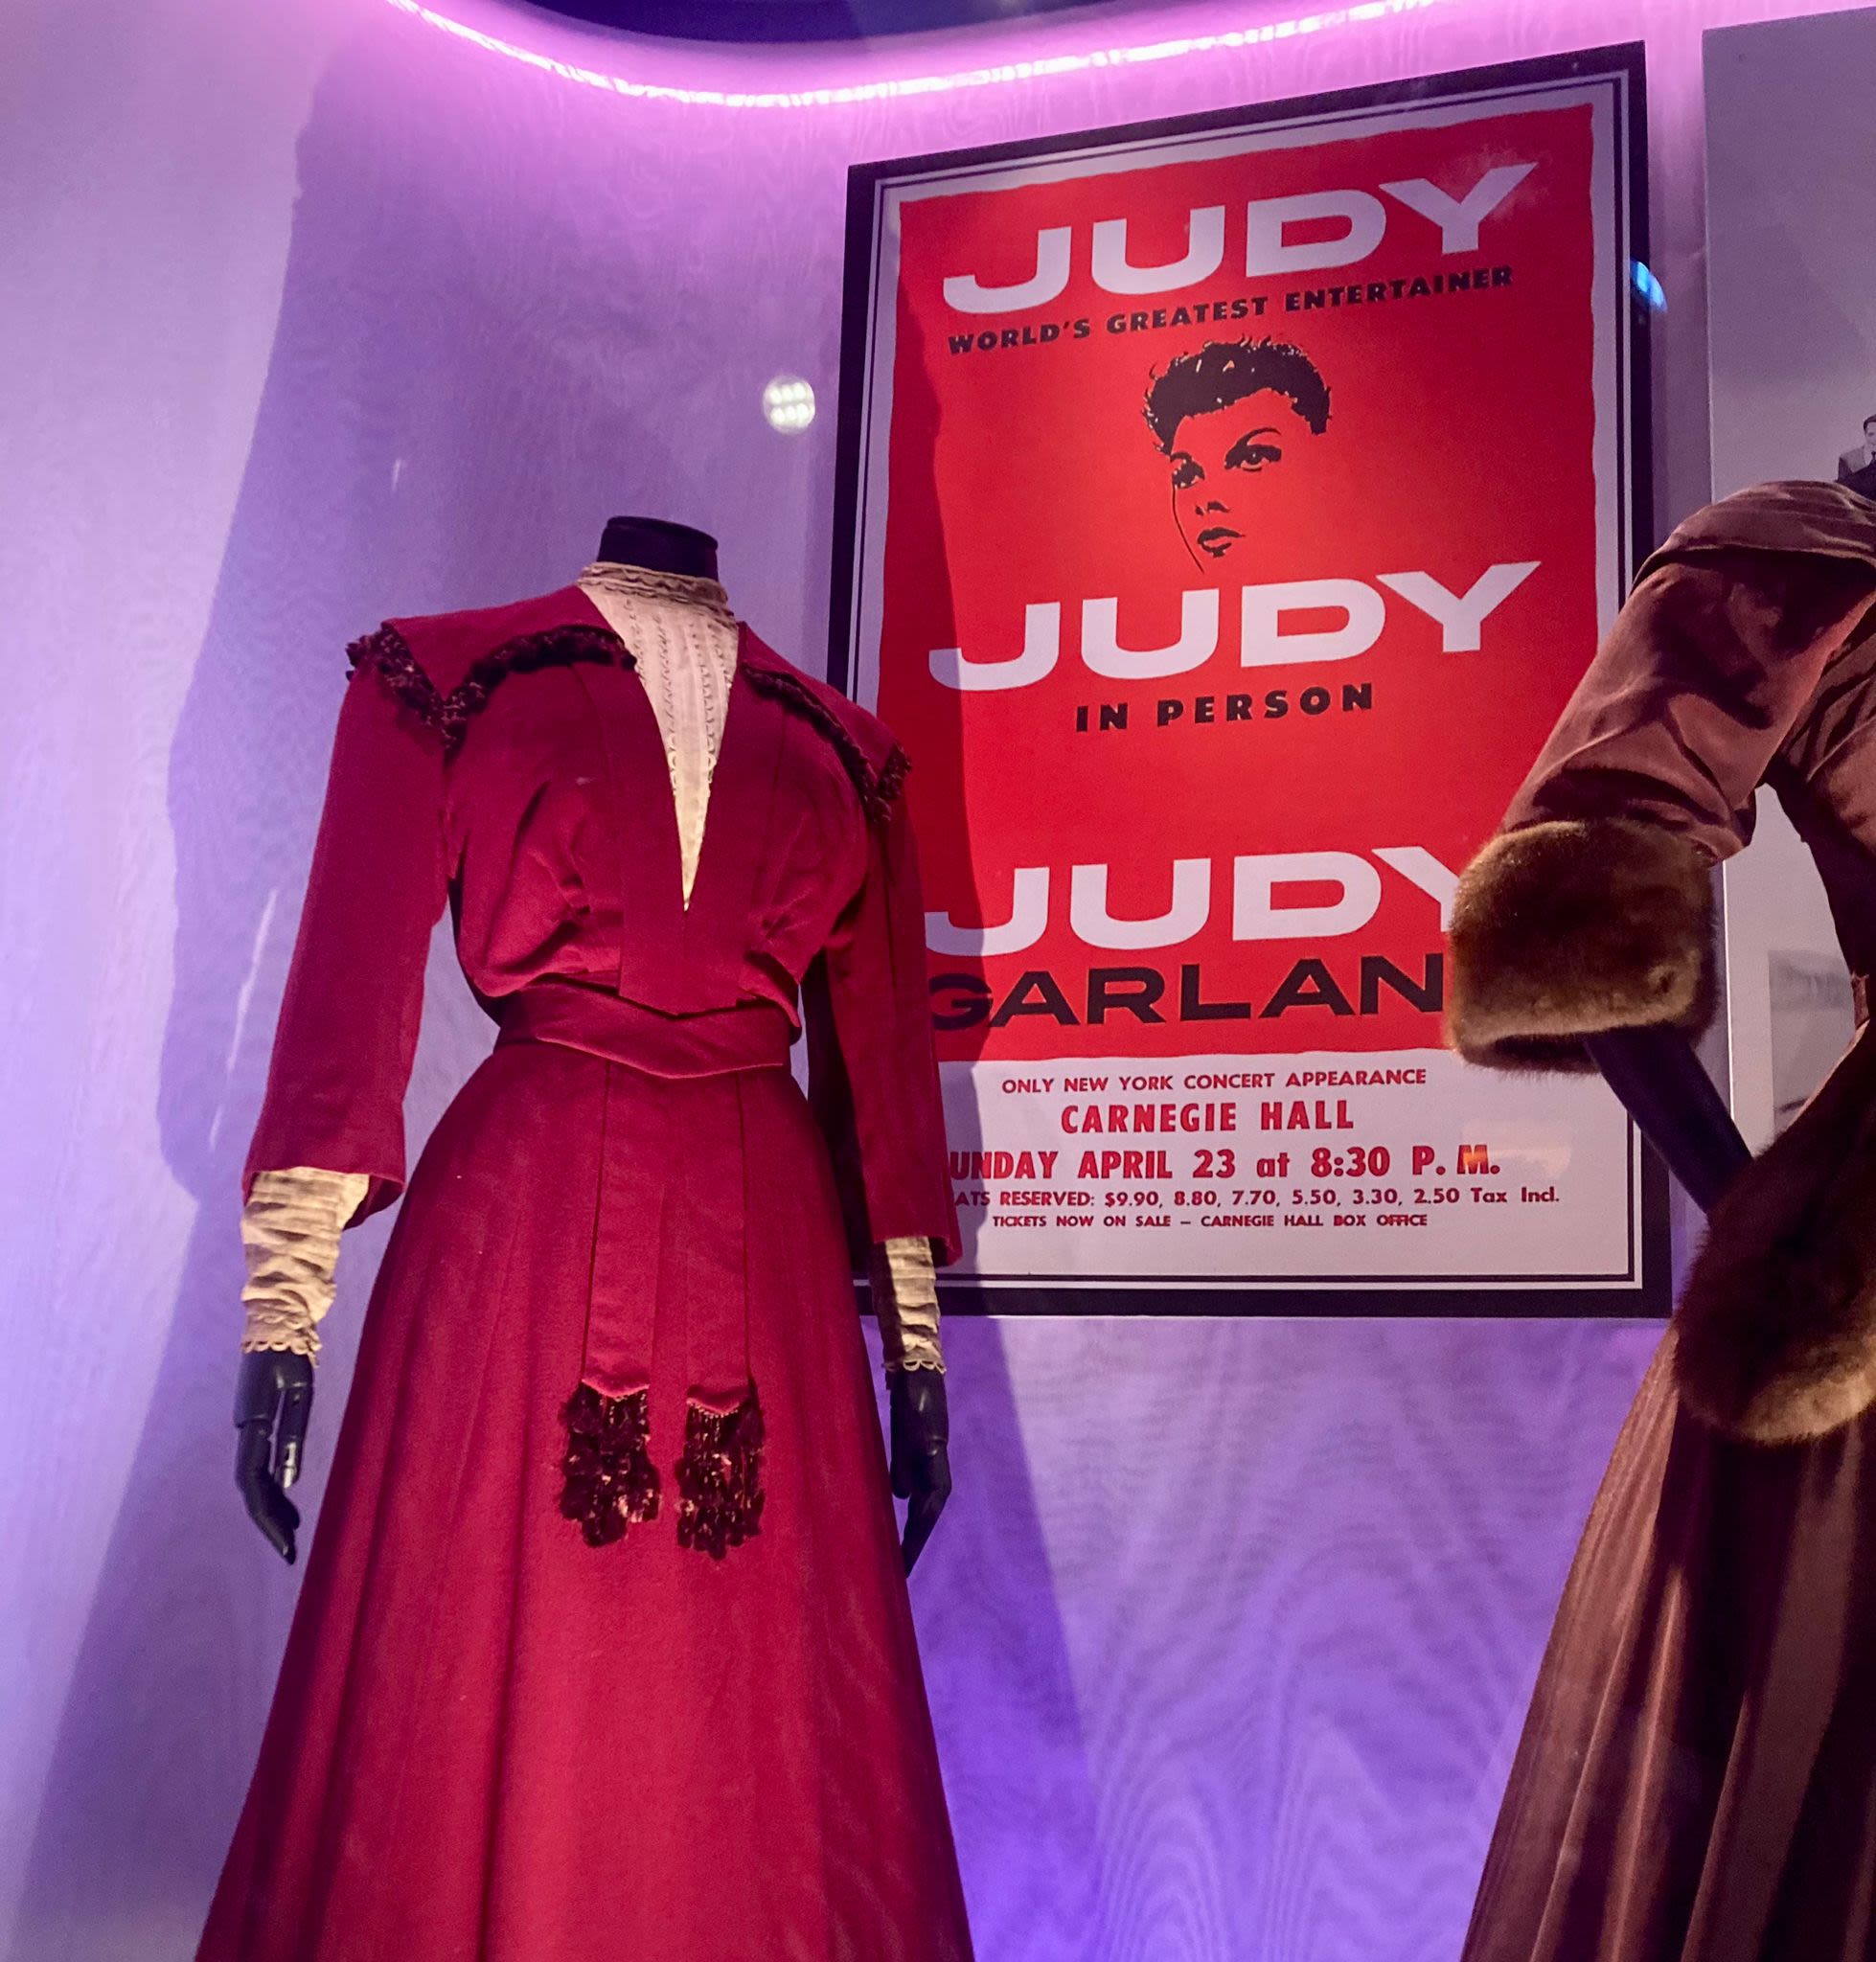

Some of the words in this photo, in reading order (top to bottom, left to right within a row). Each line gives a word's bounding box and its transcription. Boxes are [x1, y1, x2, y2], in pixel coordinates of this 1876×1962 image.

[943, 163, 1539, 313] JUDY
[948, 318, 1090, 354] WORLD'S
[1107, 296, 1269, 333] GREATEST
[1285, 265, 1513, 312] ENTERTAINER
[928, 561, 1541, 691] JUDY
[1076, 702, 1129, 732] IN
[1157, 682, 1372, 727] PERSON
[929, 953, 1444, 1031] GARLAN
[1001, 1078, 1055, 1093] ONLY
[1064, 1077, 1110, 1092] NEW
[1118, 1075, 1174, 1091] YORK
[1183, 1072, 1275, 1089] CONCERT
[1285, 1068, 1427, 1087] APPEARANCE
[1061, 1102, 1237, 1134] CARNEGIE
[1260, 1099, 1354, 1131] HALL
[949, 1151, 1059, 1180] UNDAY
[1077, 1150, 1173, 1179] APRIL
[1192, 1149, 1236, 1179] 23
[1256, 1152, 1291, 1178] at
[1311, 1146, 1391, 1178] 8:30
[954, 1191, 991, 1207] ATS
[999, 1191, 1095, 1207] RESERVED:
[1104, 1190, 1163, 1209] $9.90,
[1174, 1190, 1222, 1208] 8.80,
[1232, 1189, 1280, 1207] 7.70,
[1292, 1189, 1341, 1207] 5.50,
[1352, 1188, 1403, 1207] 3.30,
[1413, 1187, 1460, 1204] 2.50
[1470, 1187, 1508, 1203] Tax
[1521, 1186, 1560, 1203] Incl.
[992, 1215, 1047, 1227] TICKETS
[1056, 1215, 1094, 1227] NOW
[1103, 1215, 1127, 1227] ON
[1135, 1215, 1172, 1227] SALE
[1201, 1215, 1274, 1227] CARNEGIE
[1284, 1214, 1324, 1227] HALL
[1333, 1214, 1366, 1227] BOX
[1376, 1214, 1428, 1227] OFFICE
